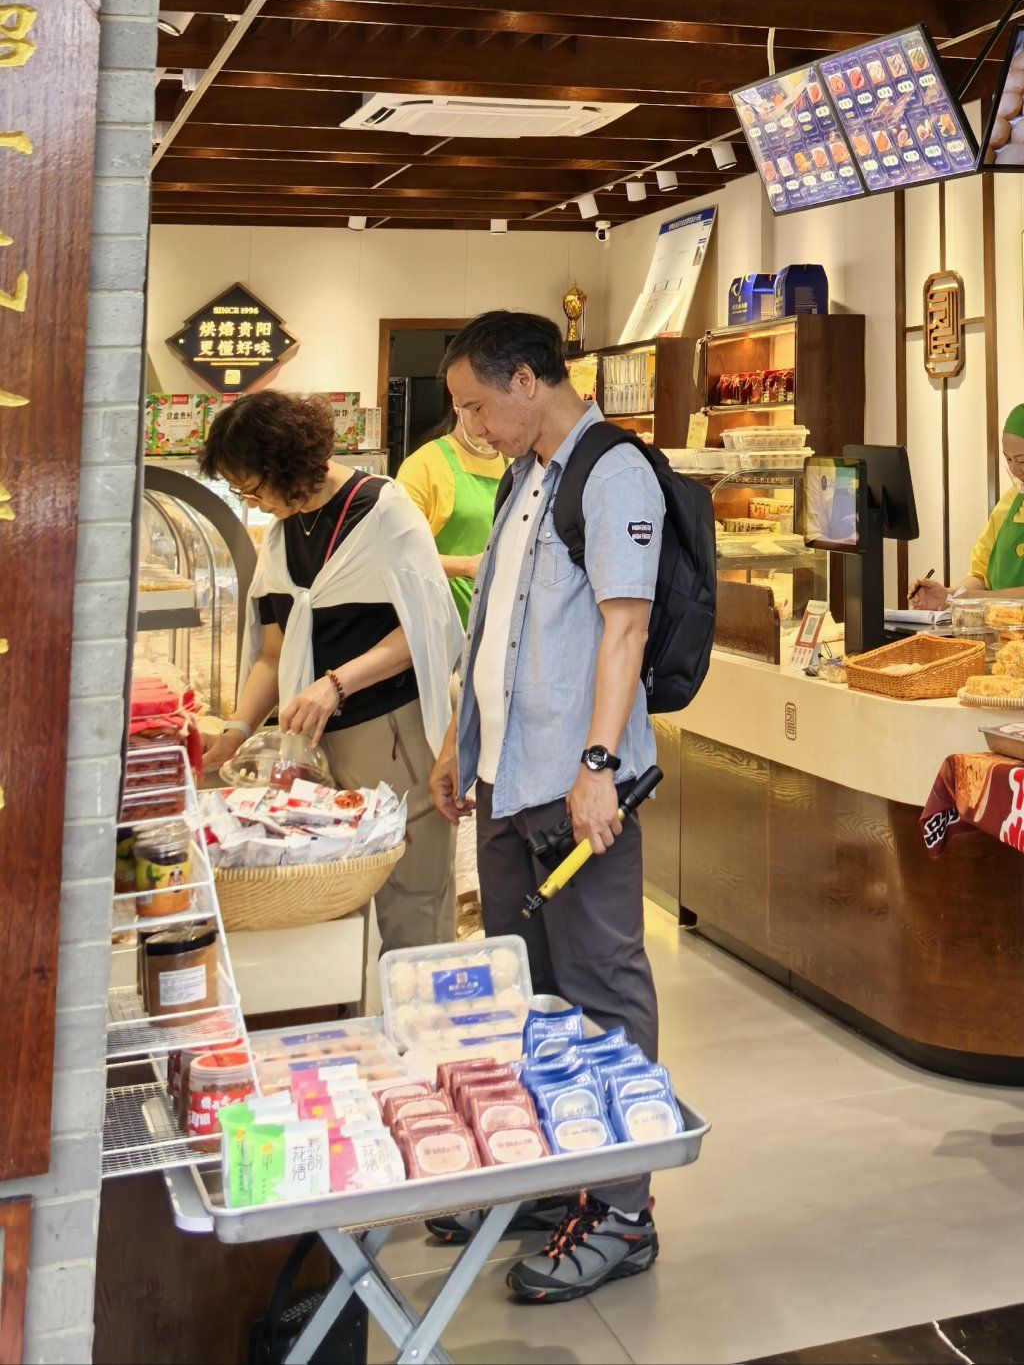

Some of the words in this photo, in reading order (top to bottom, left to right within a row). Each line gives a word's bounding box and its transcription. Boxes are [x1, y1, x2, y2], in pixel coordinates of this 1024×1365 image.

[213, 306, 239, 315] SINCE
[199, 321, 272, 338] 烘焙贵阳
[198, 340, 272, 356] 更懂好味
